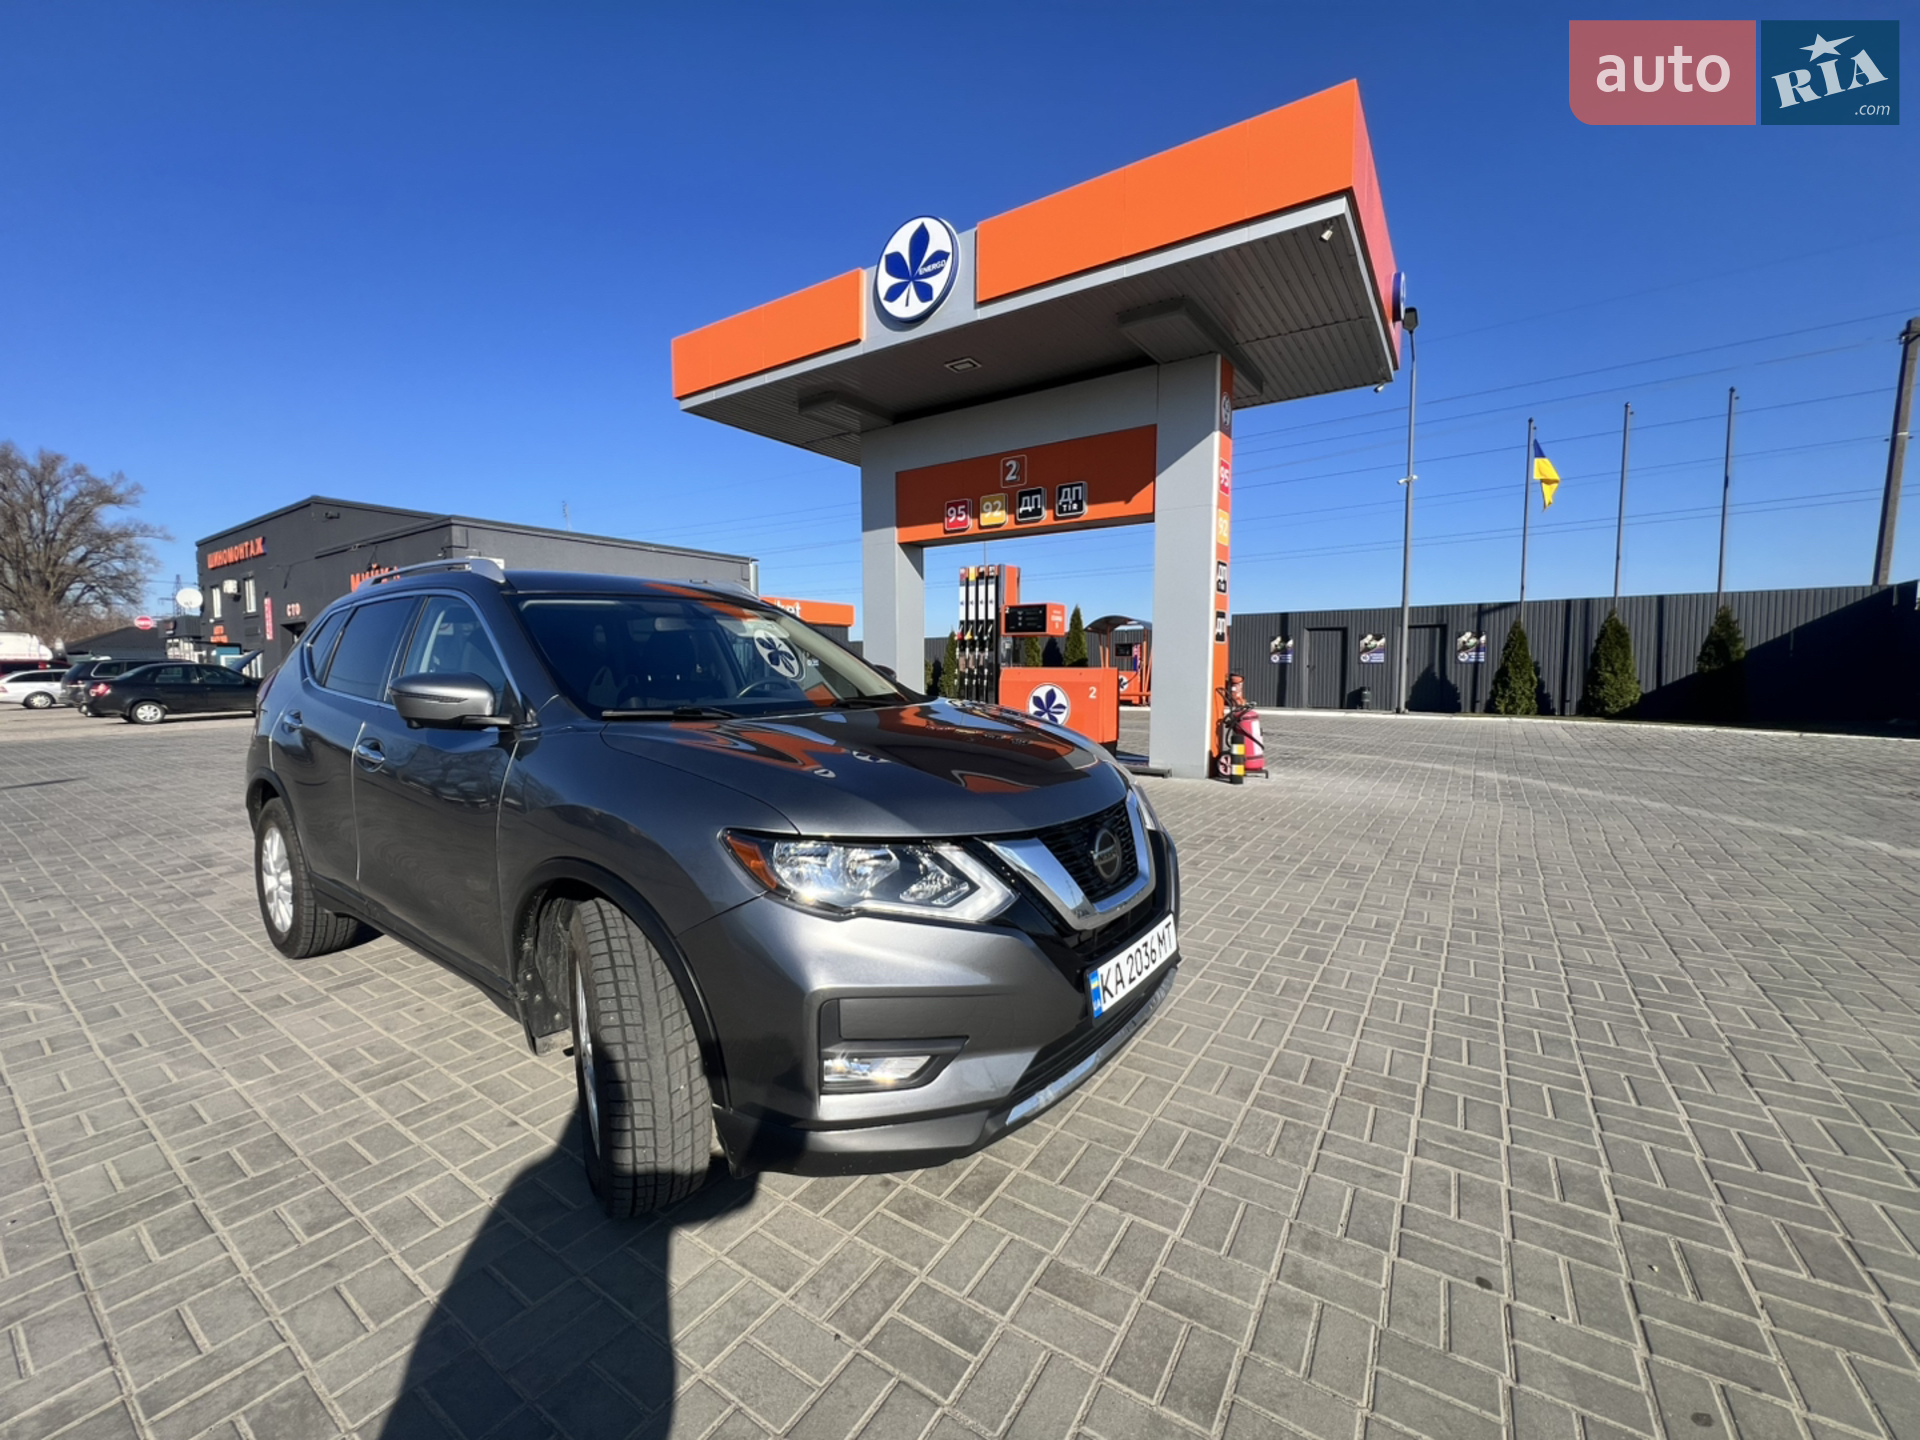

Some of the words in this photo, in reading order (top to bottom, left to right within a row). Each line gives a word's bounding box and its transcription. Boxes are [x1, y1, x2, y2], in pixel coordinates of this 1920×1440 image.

[1005, 460, 1018, 481] 2
[1019, 494, 1041, 514] ДП
[1059, 485, 1083, 506] ДП
[947, 505, 966, 523] 95
[982, 500, 1002, 518] 92
[1088, 686, 1097, 699] 2
[1100, 962, 1126, 1004] KA
[1126, 935, 1157, 985] 2036
[1157, 921, 1173, 960] MT
